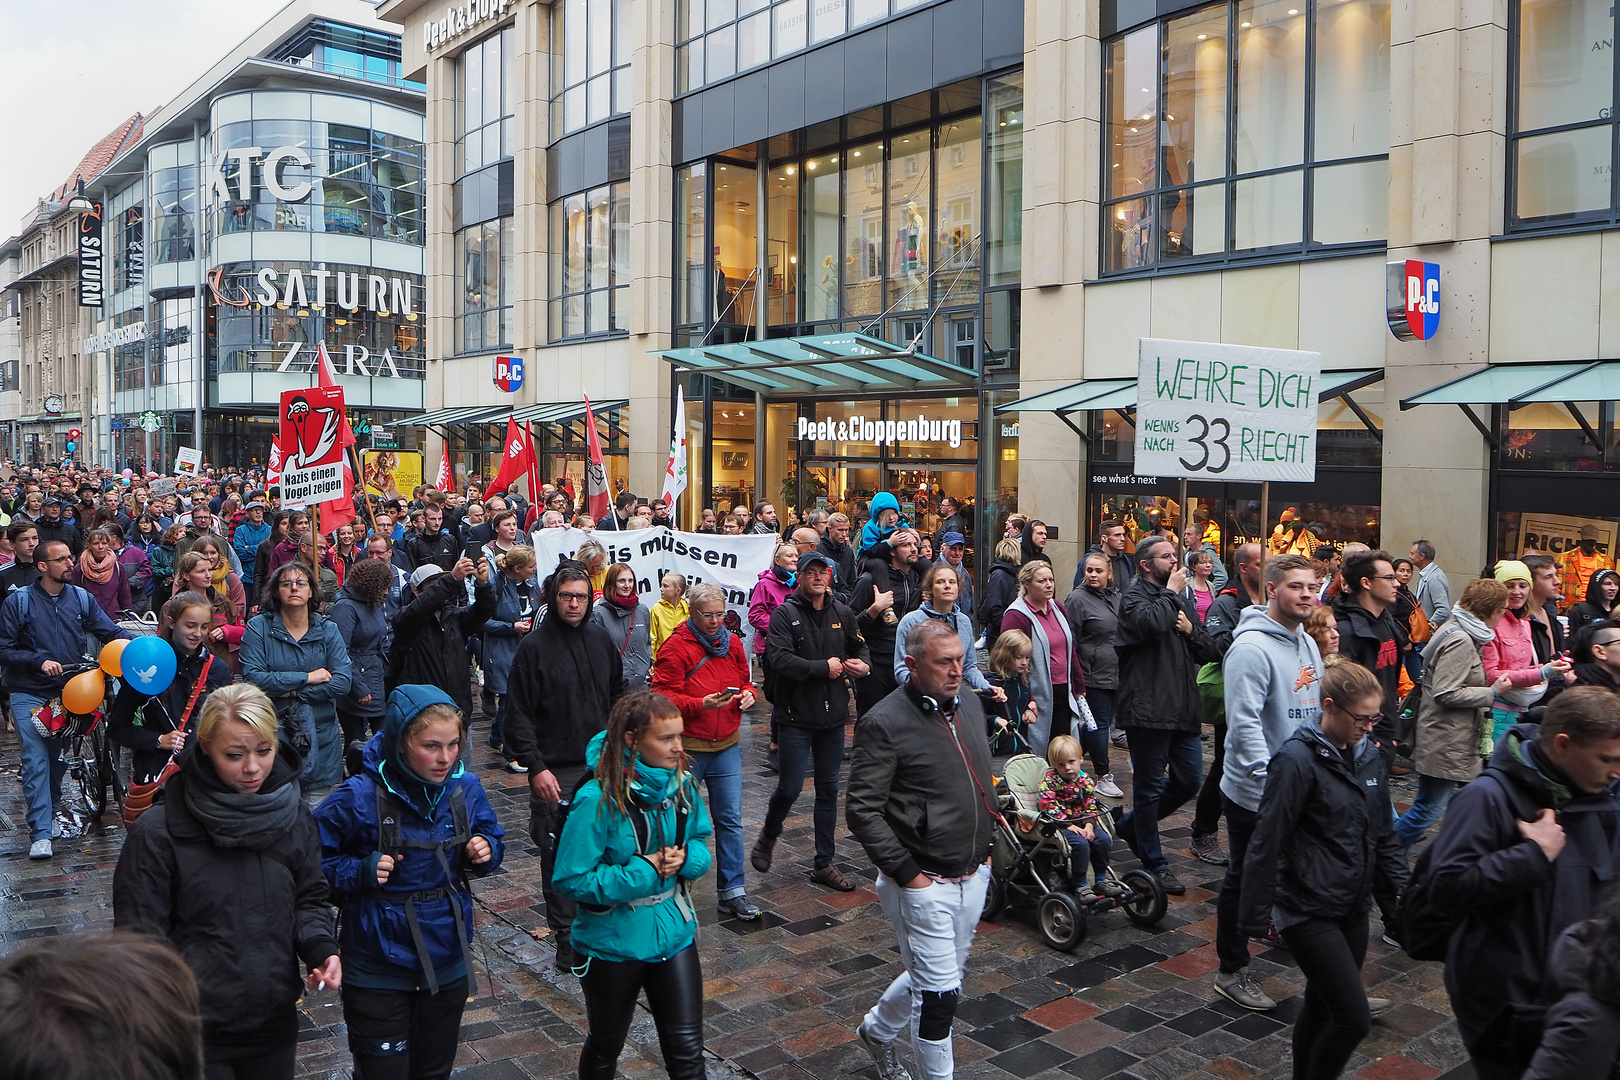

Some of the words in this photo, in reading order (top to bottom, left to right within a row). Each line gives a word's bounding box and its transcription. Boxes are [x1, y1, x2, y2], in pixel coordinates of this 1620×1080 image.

[205, 146, 312, 205] KTC
[81, 235, 101, 305] SATURN
[257, 267, 412, 315] SATURN
[1407, 275, 1439, 314] P&C
[497, 363, 521, 381] P&C
[1156, 356, 1249, 406] WEHRE
[1258, 368, 1312, 409] DICH
[798, 414, 962, 448] Peek&Cloppenburg
[1143, 437, 1175, 451] NACH
[1178, 413, 1231, 474] 33
[1240, 427, 1310, 464] RIECHT
[285, 471, 309, 487] Nazis
[311, 467, 336, 481] einen
[285, 484, 311, 500] Vogel
[313, 479, 341, 494] zeigen
[1093, 475, 1107, 483] see
[1137, 476, 1157, 485] next
[558, 544, 632, 564] Nis
[641, 530, 738, 569] müssen
